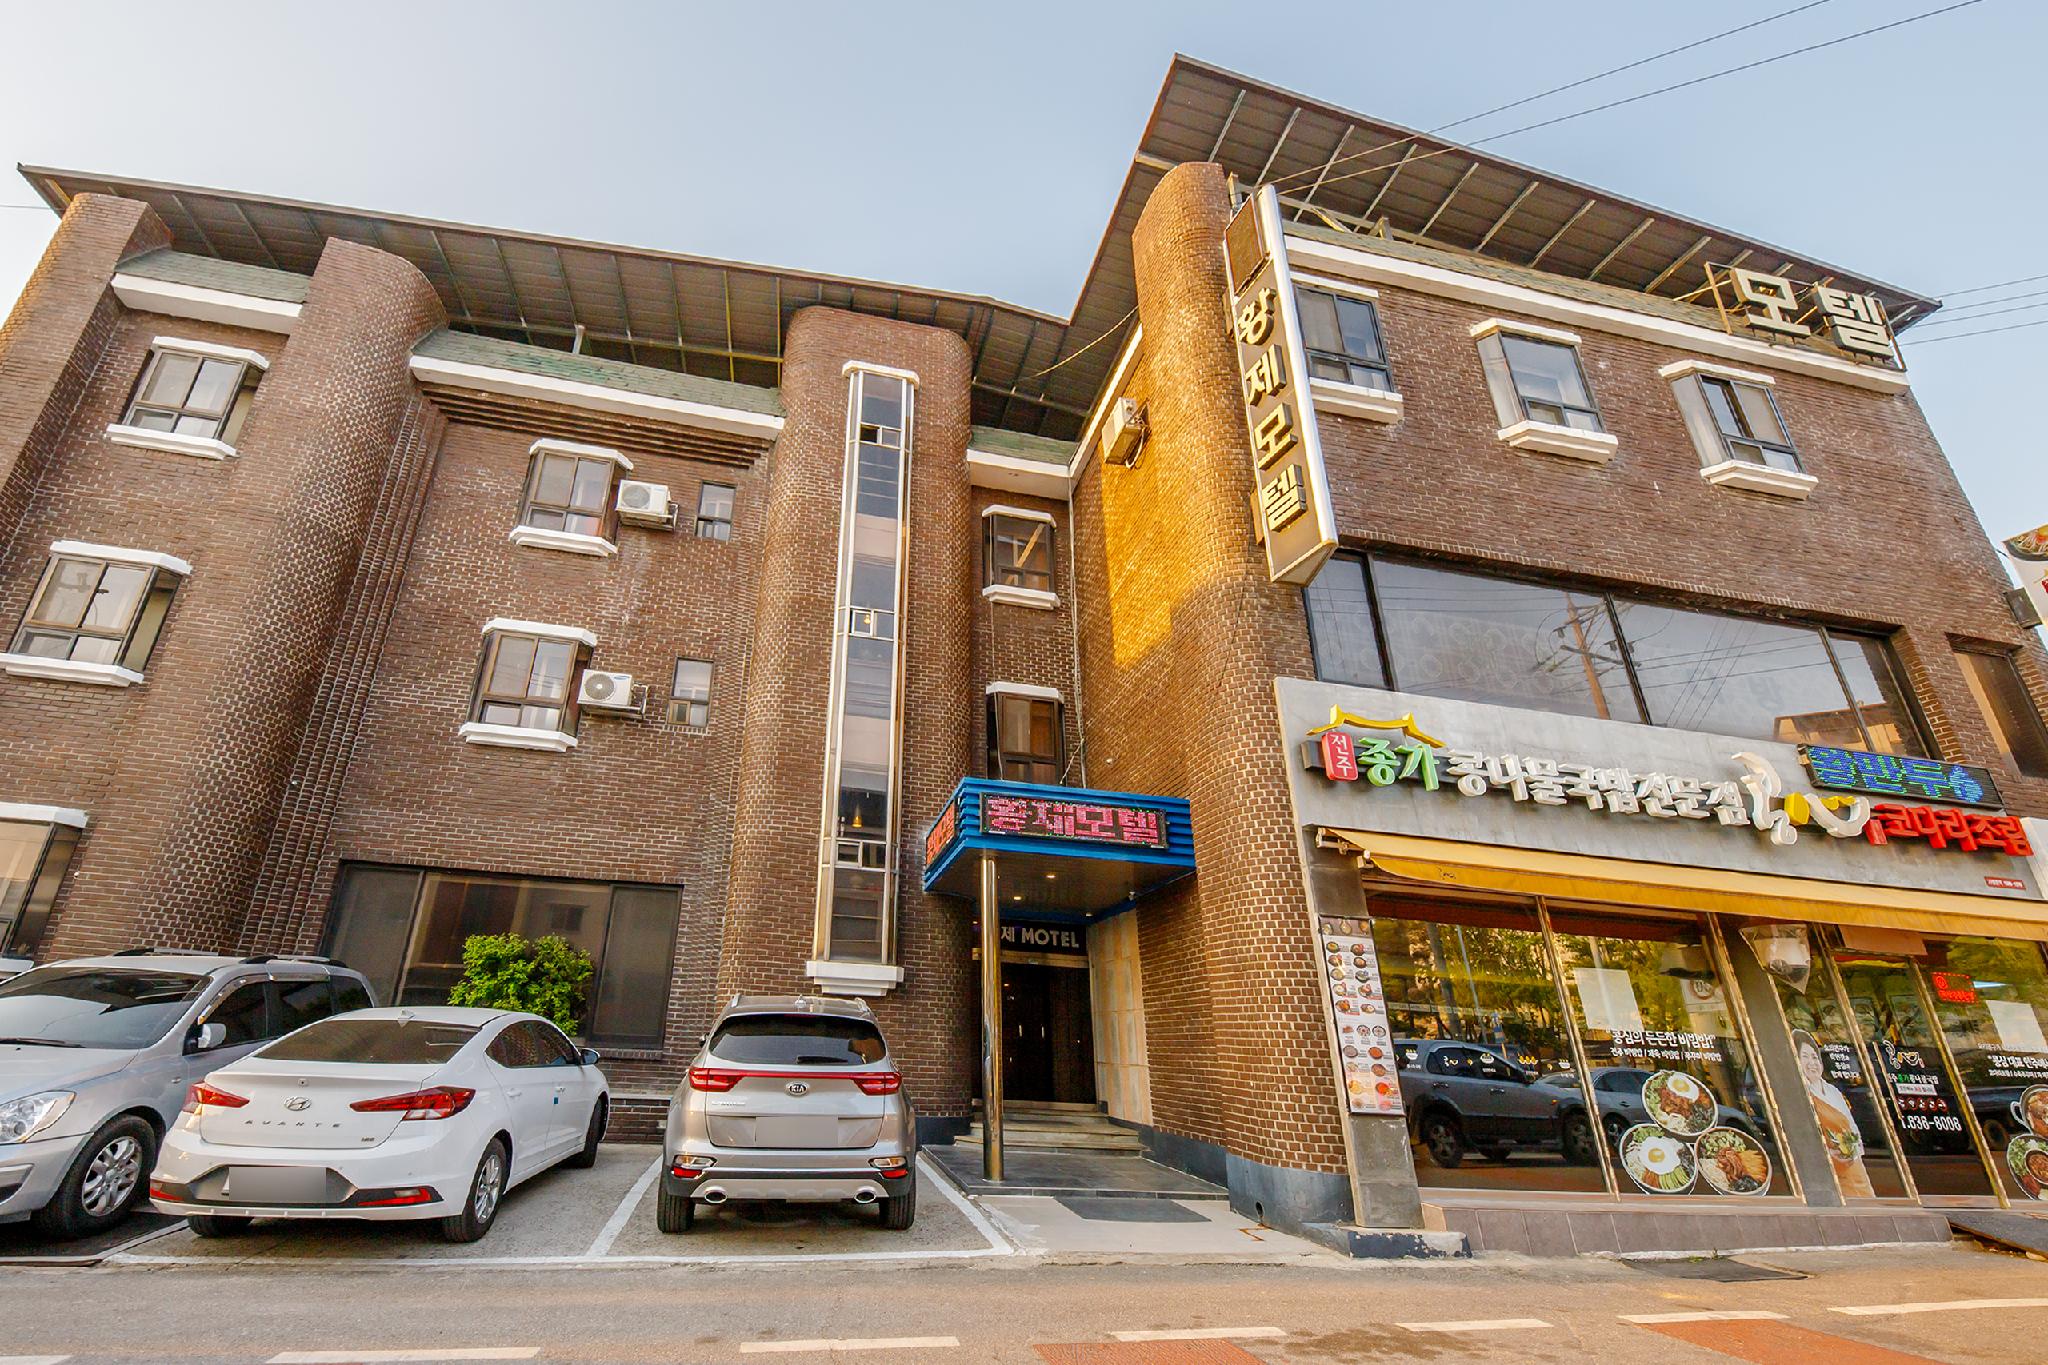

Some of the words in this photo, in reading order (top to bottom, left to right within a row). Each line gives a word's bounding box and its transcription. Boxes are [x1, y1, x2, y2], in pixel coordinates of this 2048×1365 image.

[1729, 267, 1895, 359] 모텔
[1238, 287, 1308, 534] 황제모텔
[1330, 734, 1354, 777] 전주
[1357, 737, 1441, 791] 종가
[1446, 749, 1751, 826] 콩나물국밥전문점
[986, 798, 1160, 845] 황제모텔
[1872, 803, 2035, 856] 코다리조림
[1021, 927, 1080, 948] MOTEL
[790, 1083, 806, 1093] KIA
